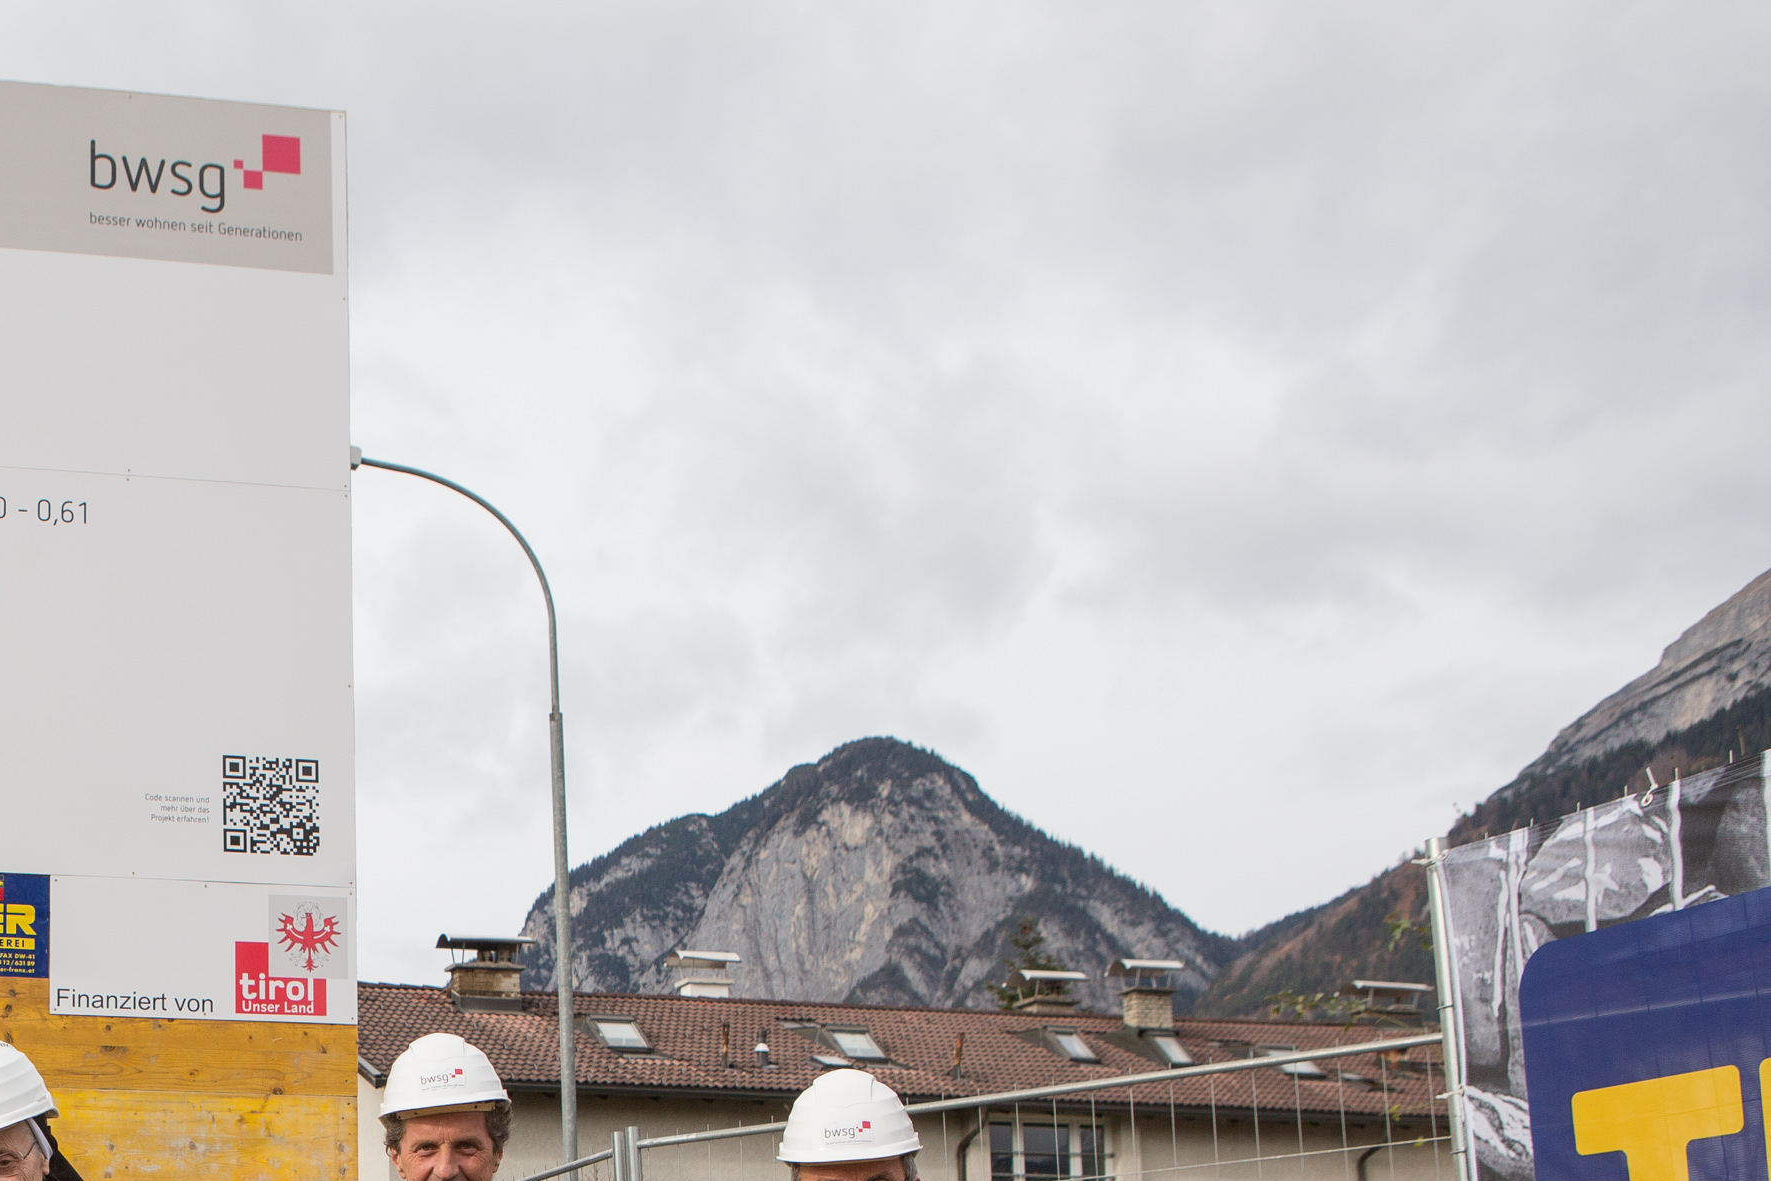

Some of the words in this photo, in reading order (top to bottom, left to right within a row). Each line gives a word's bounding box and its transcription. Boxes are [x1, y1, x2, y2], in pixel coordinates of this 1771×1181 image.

[90, 139, 225, 214] bwsg
[90, 212, 131, 227] besser
[135, 217, 186, 231] wohnen
[191, 221, 213, 234] seit
[218, 223, 302, 241] Generationen
[37, 499, 88, 525] 0,61
[145, 793, 162, 802] Code
[164, 795, 194, 803] scannen
[196, 795, 209, 803] und
[161, 804, 178, 812] mehr
[180, 804, 195, 813] über
[198, 805, 209, 814] das
[150, 814, 175, 823] Projekt
[177, 815, 209, 824] erfahren!
[239, 973, 314, 1001] tirol
[56, 989, 166, 1012] Finanziert
[174, 996, 214, 1012] von
[242, 1000, 281, 1013] Unser
[284, 1001, 314, 1014] Land
[420, 1074, 448, 1085] bwsg
[825, 1128, 855, 1138] bwsg
